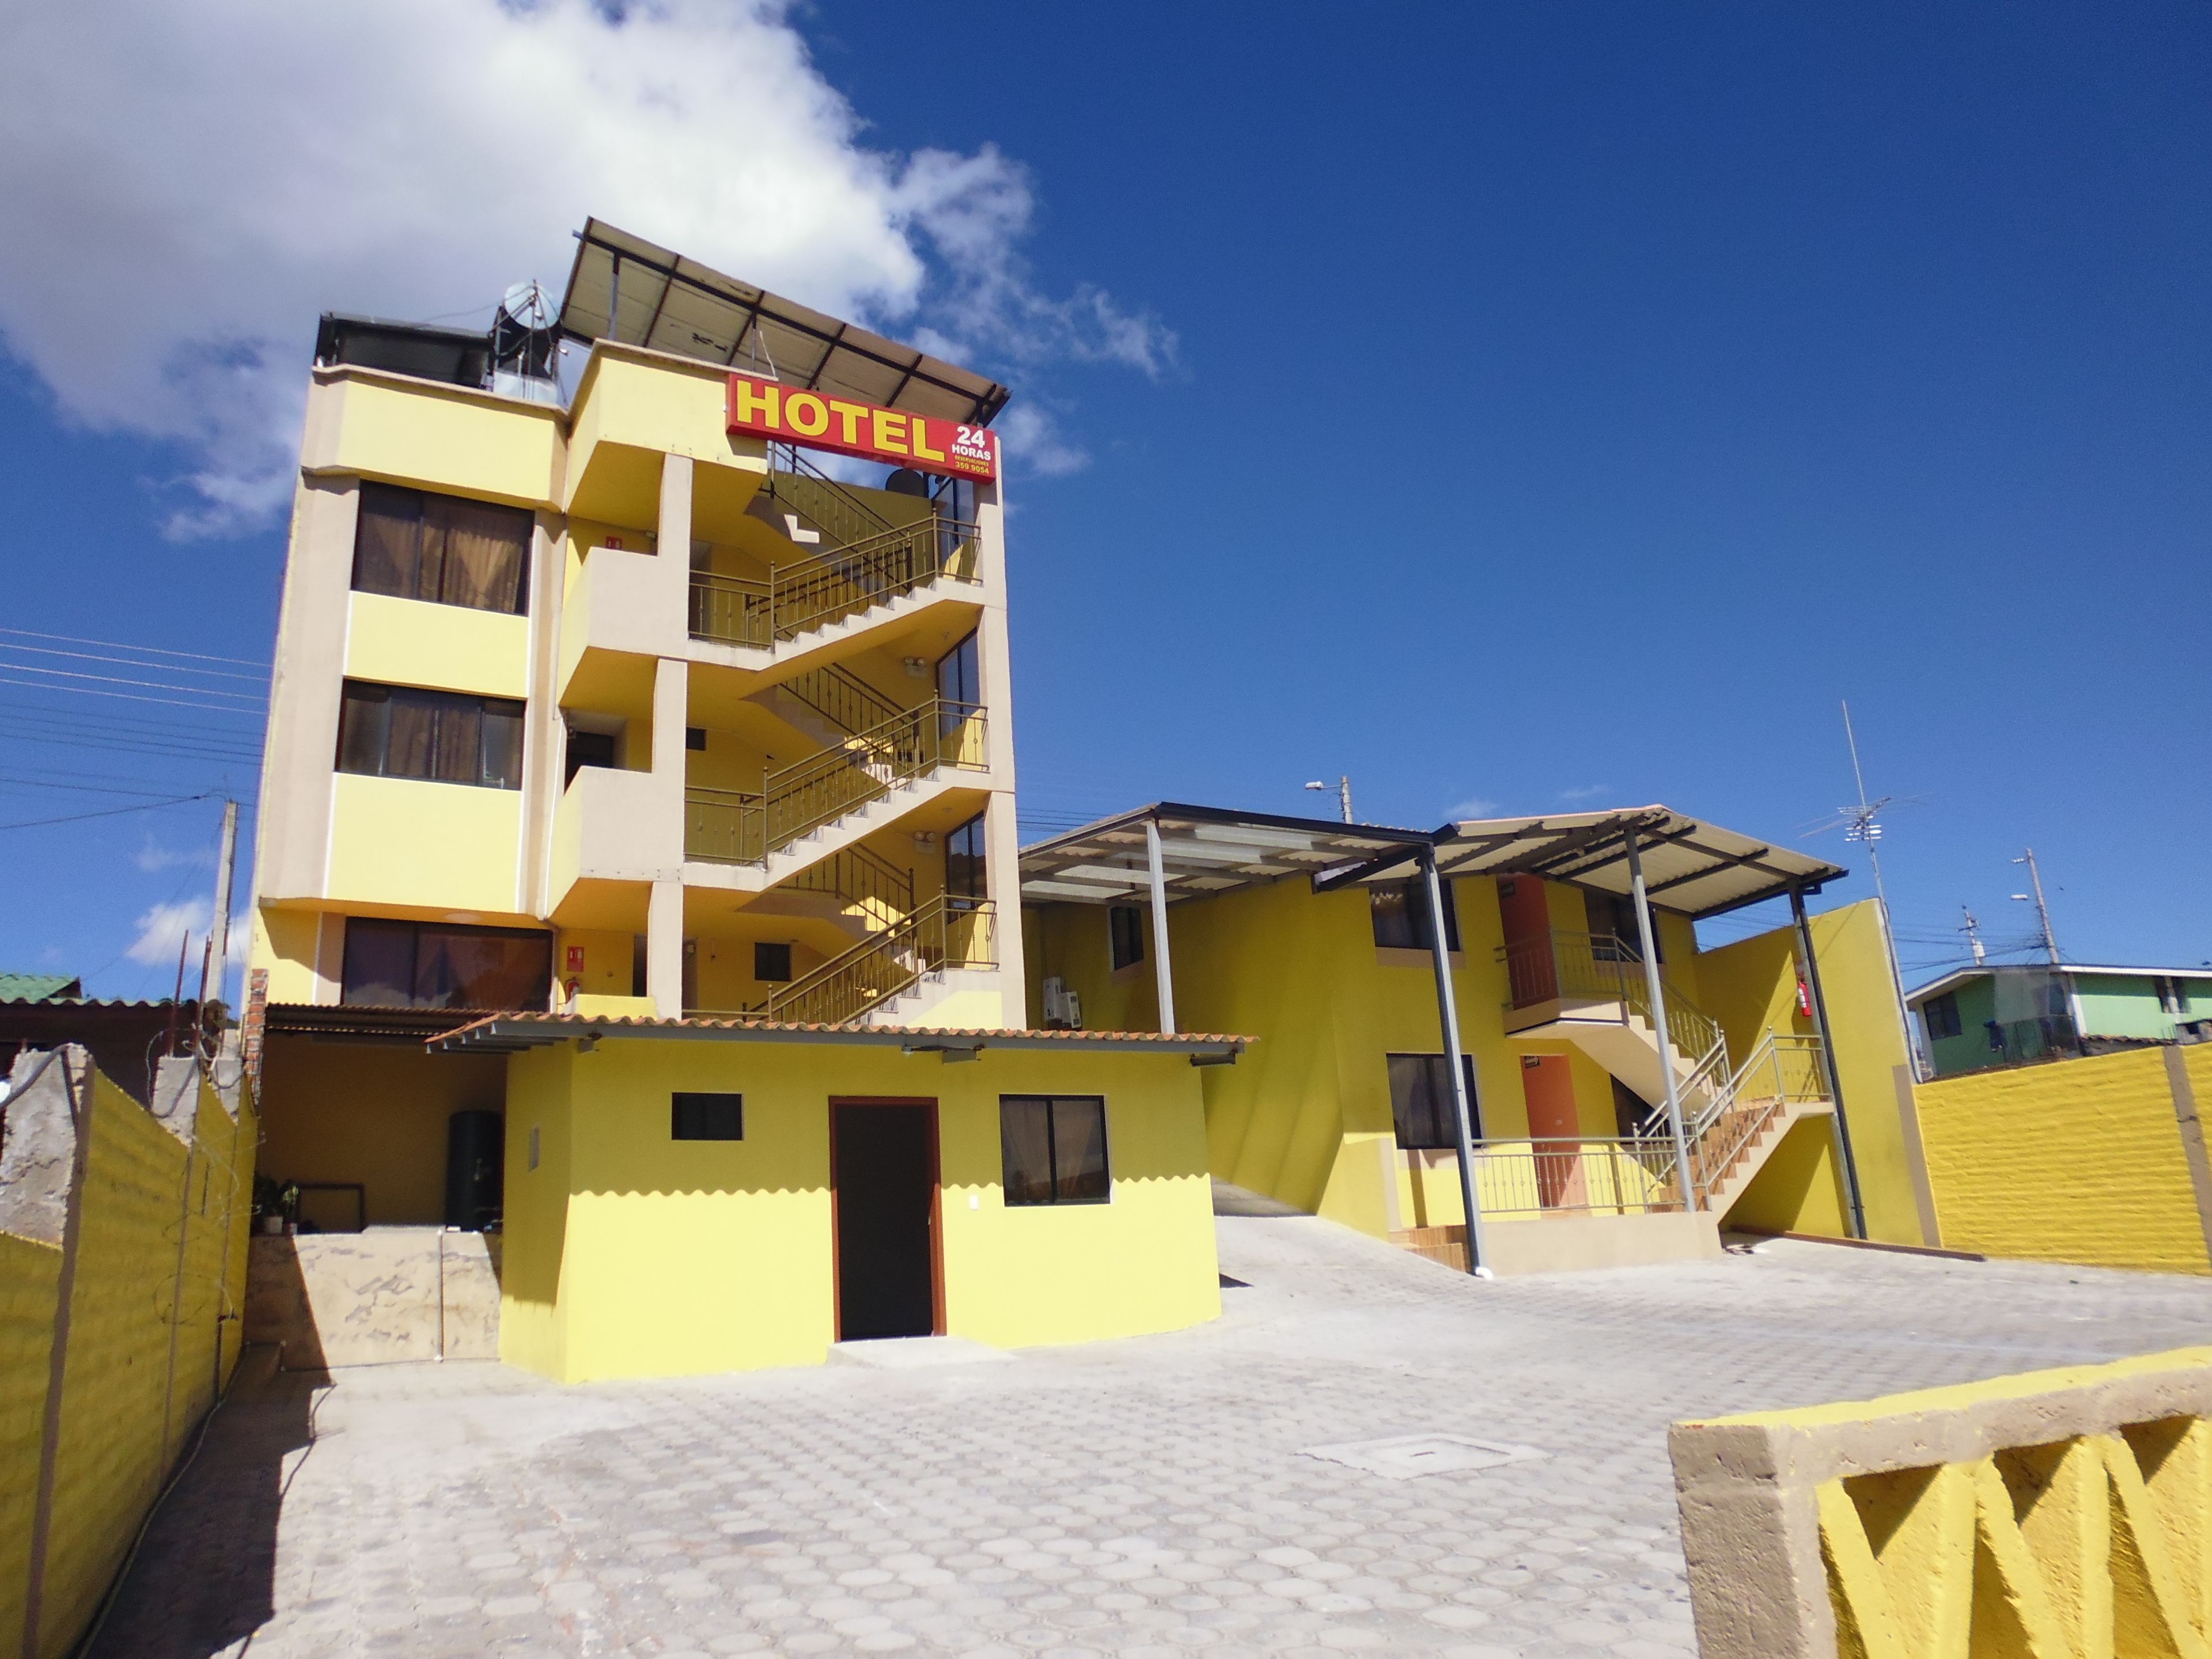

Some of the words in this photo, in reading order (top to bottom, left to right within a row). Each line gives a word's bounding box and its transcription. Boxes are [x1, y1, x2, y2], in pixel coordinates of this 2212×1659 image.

[737, 380, 945, 463] HOTEL
[957, 426, 985, 448] 24
[952, 444, 991, 461] HORAS
[956, 461, 969, 469] 359
